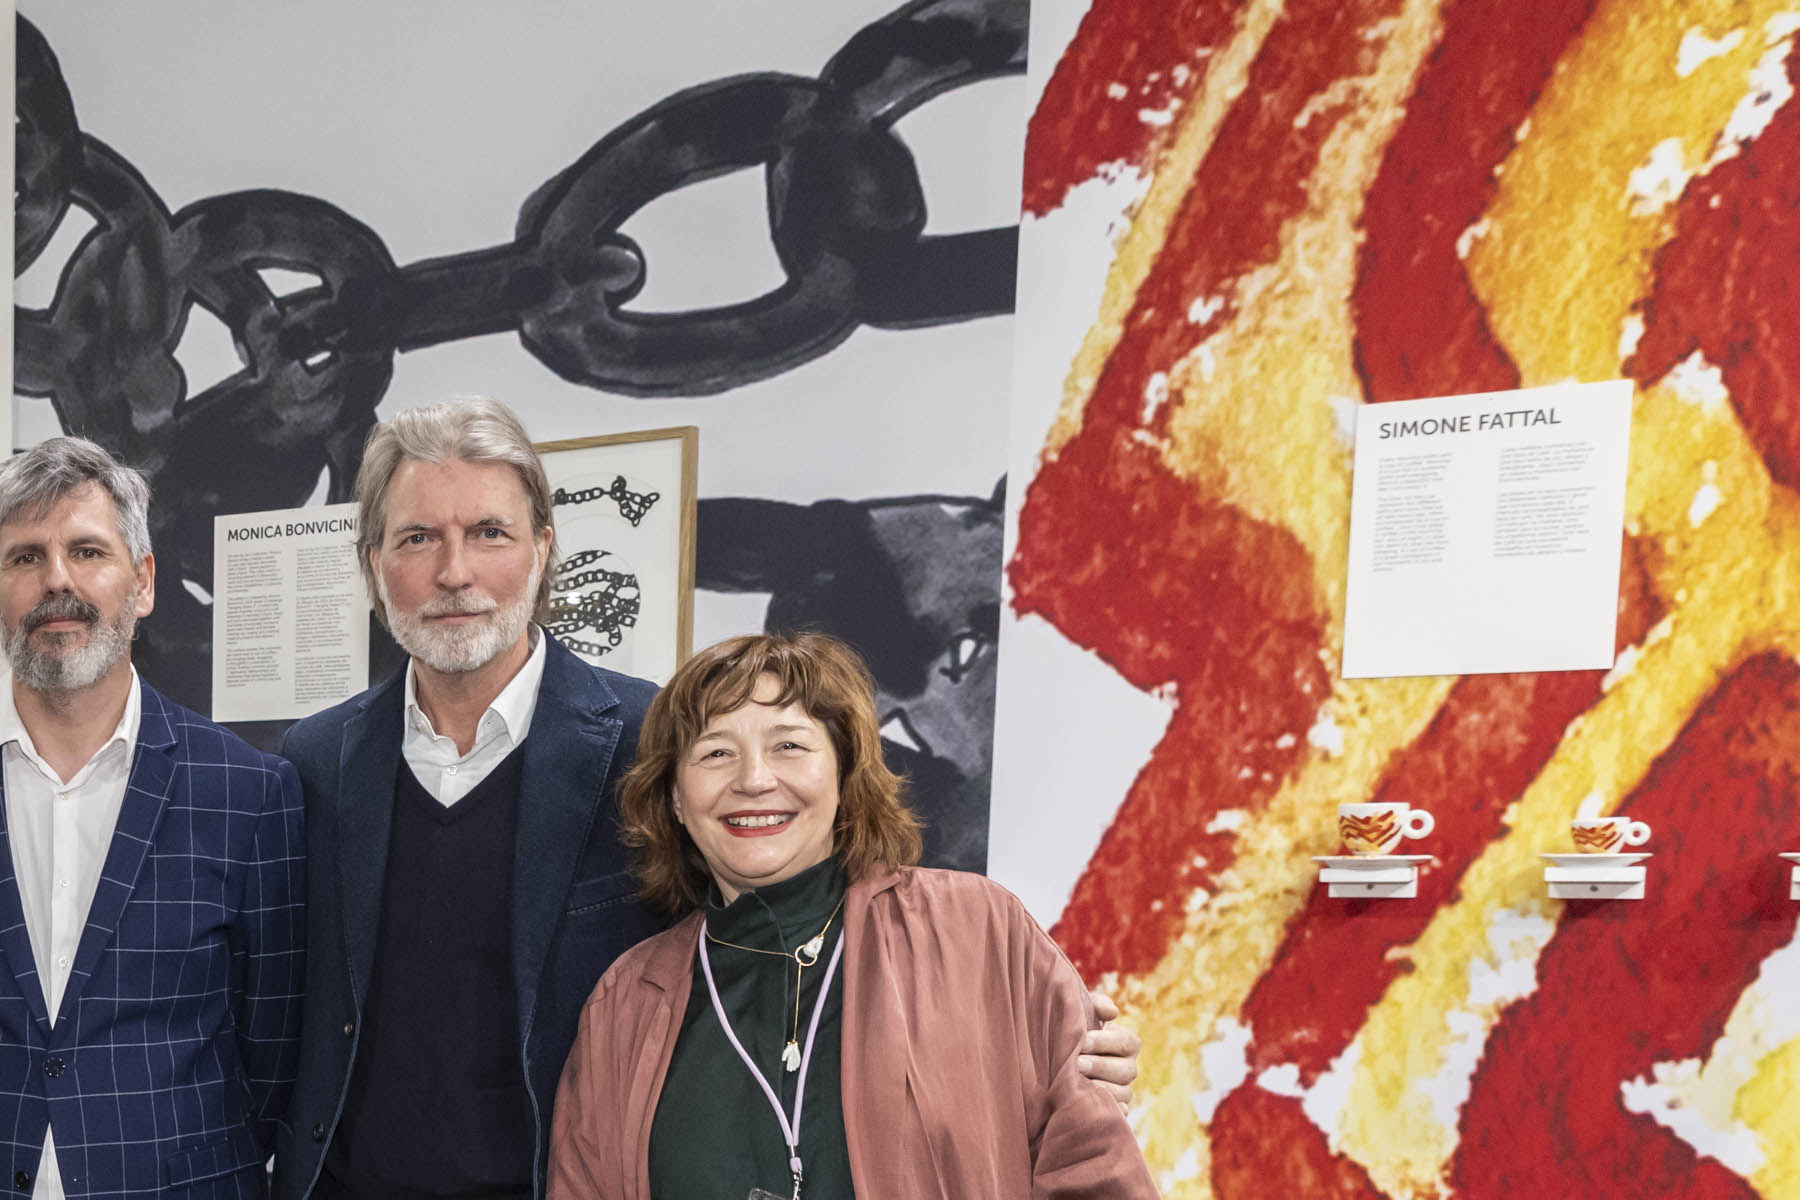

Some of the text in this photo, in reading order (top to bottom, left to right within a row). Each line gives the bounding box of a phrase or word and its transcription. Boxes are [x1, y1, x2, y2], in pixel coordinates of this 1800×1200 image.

[1379, 407, 1562, 440] SIMONE FATTAL
[227, 525, 283, 542] MONICA
